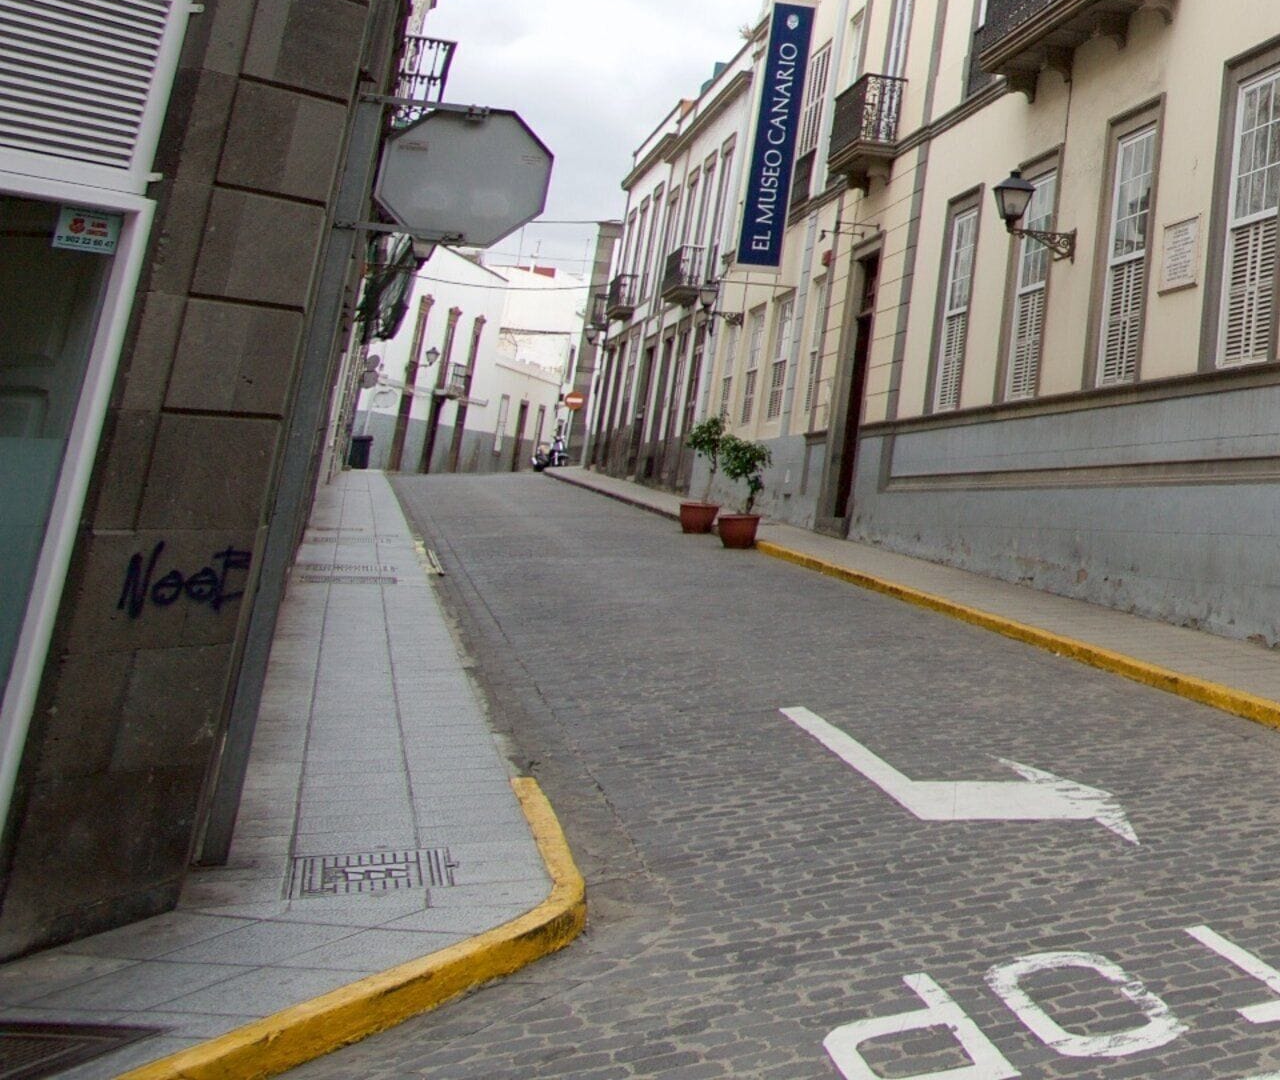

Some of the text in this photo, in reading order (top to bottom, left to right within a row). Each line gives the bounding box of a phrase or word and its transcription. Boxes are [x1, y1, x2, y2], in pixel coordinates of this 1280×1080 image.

[752, 43, 797, 251] EL MUSEO CANARIO
